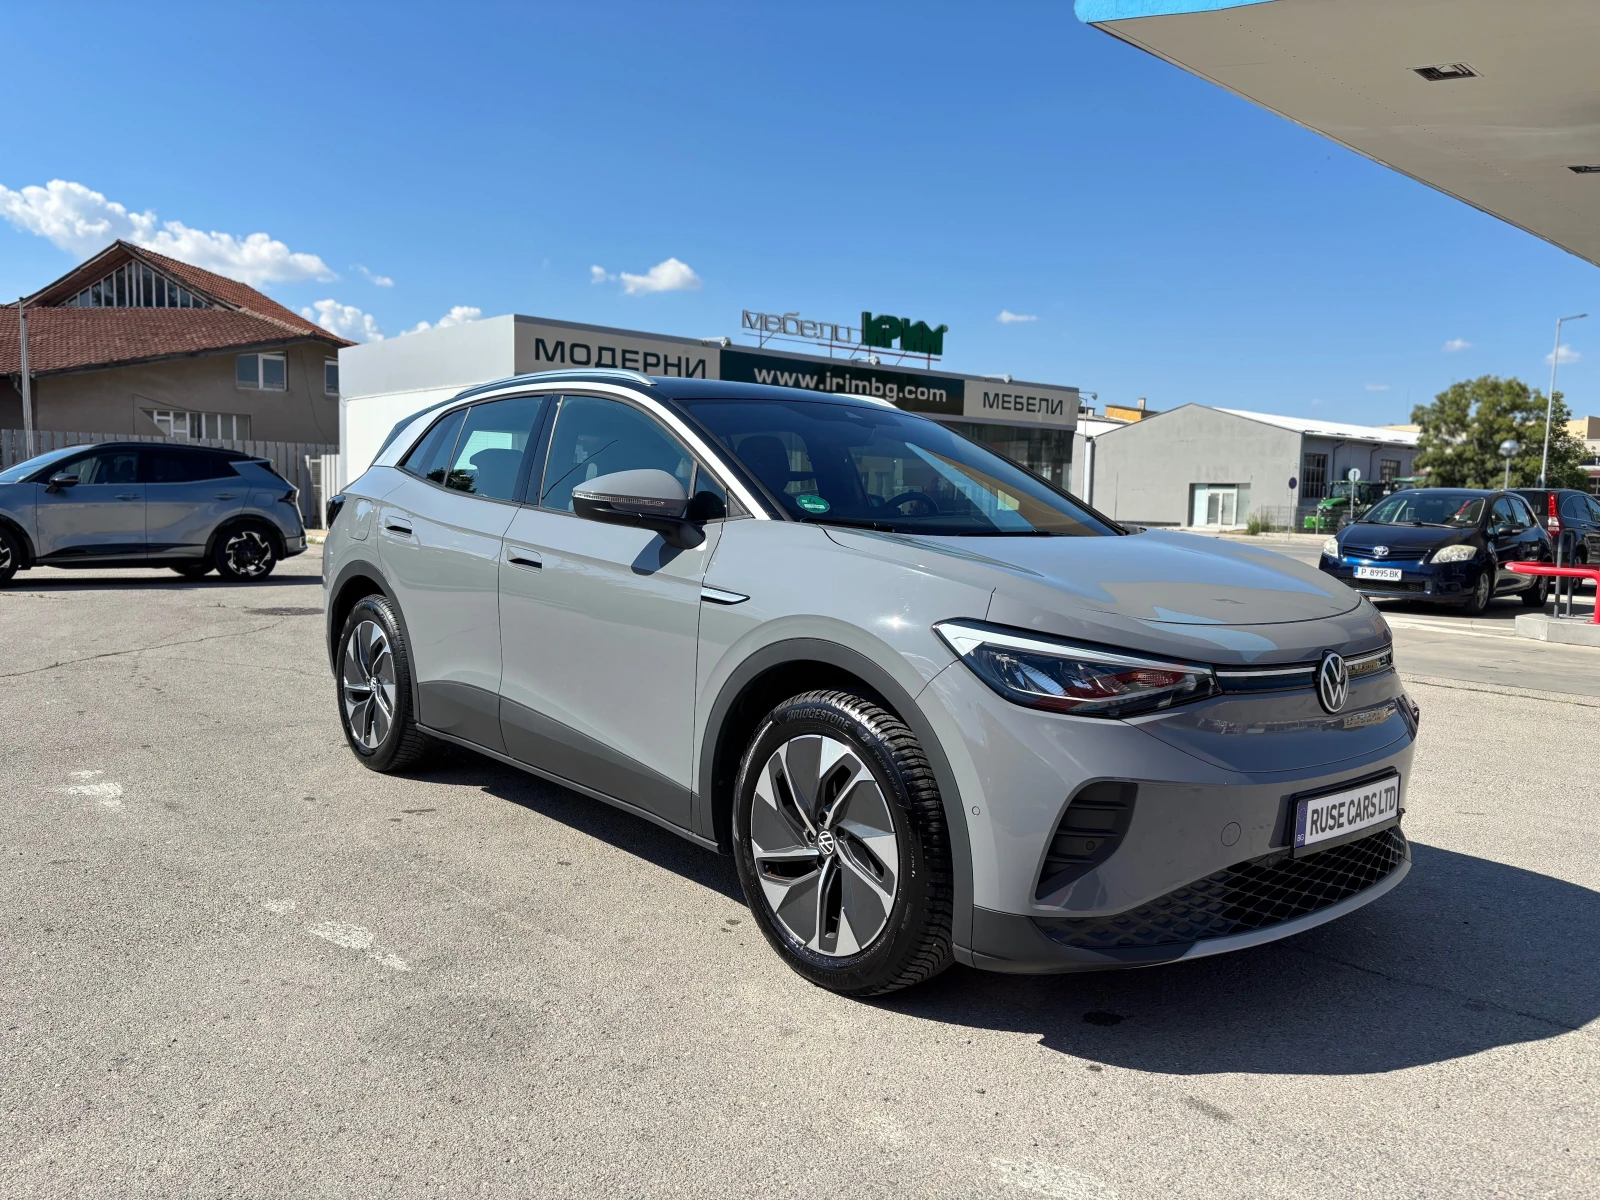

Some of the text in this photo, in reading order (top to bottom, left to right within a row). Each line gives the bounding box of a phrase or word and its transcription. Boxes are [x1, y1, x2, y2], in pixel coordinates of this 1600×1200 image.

[535, 338, 706, 379] МОДЕРНИ
[754, 368, 946, 402] www.irimbg.com
[983, 391, 1063, 415] МЕБЕЛИ
[1361, 568, 1400, 579] P 8995 BK
[786, 707, 851, 731] BRIDGESTONE
[1310, 785, 1396, 836] RUSE CARS LTD
